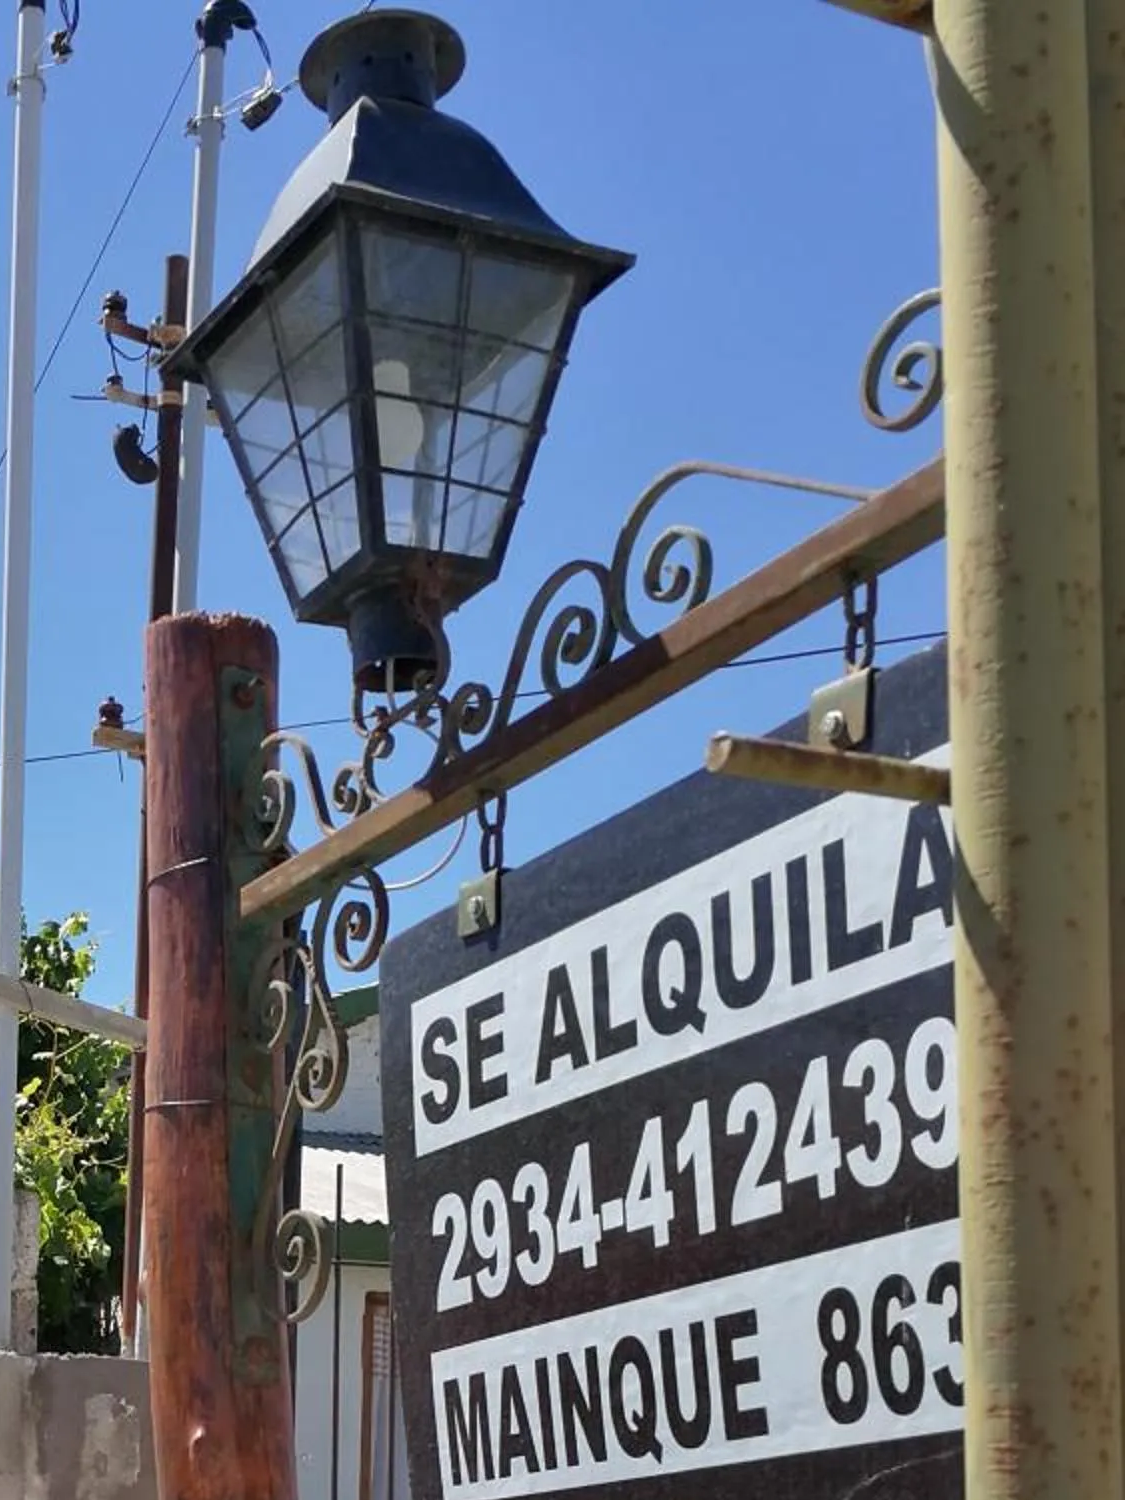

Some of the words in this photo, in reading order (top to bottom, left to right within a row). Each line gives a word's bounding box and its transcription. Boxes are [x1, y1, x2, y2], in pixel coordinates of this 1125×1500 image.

[421, 991, 508, 1125] SE
[535, 803, 954, 1086] ALQUILA
[432, 1016, 959, 1312] 2934-412439
[443, 1308, 769, 1486] MAINQUE
